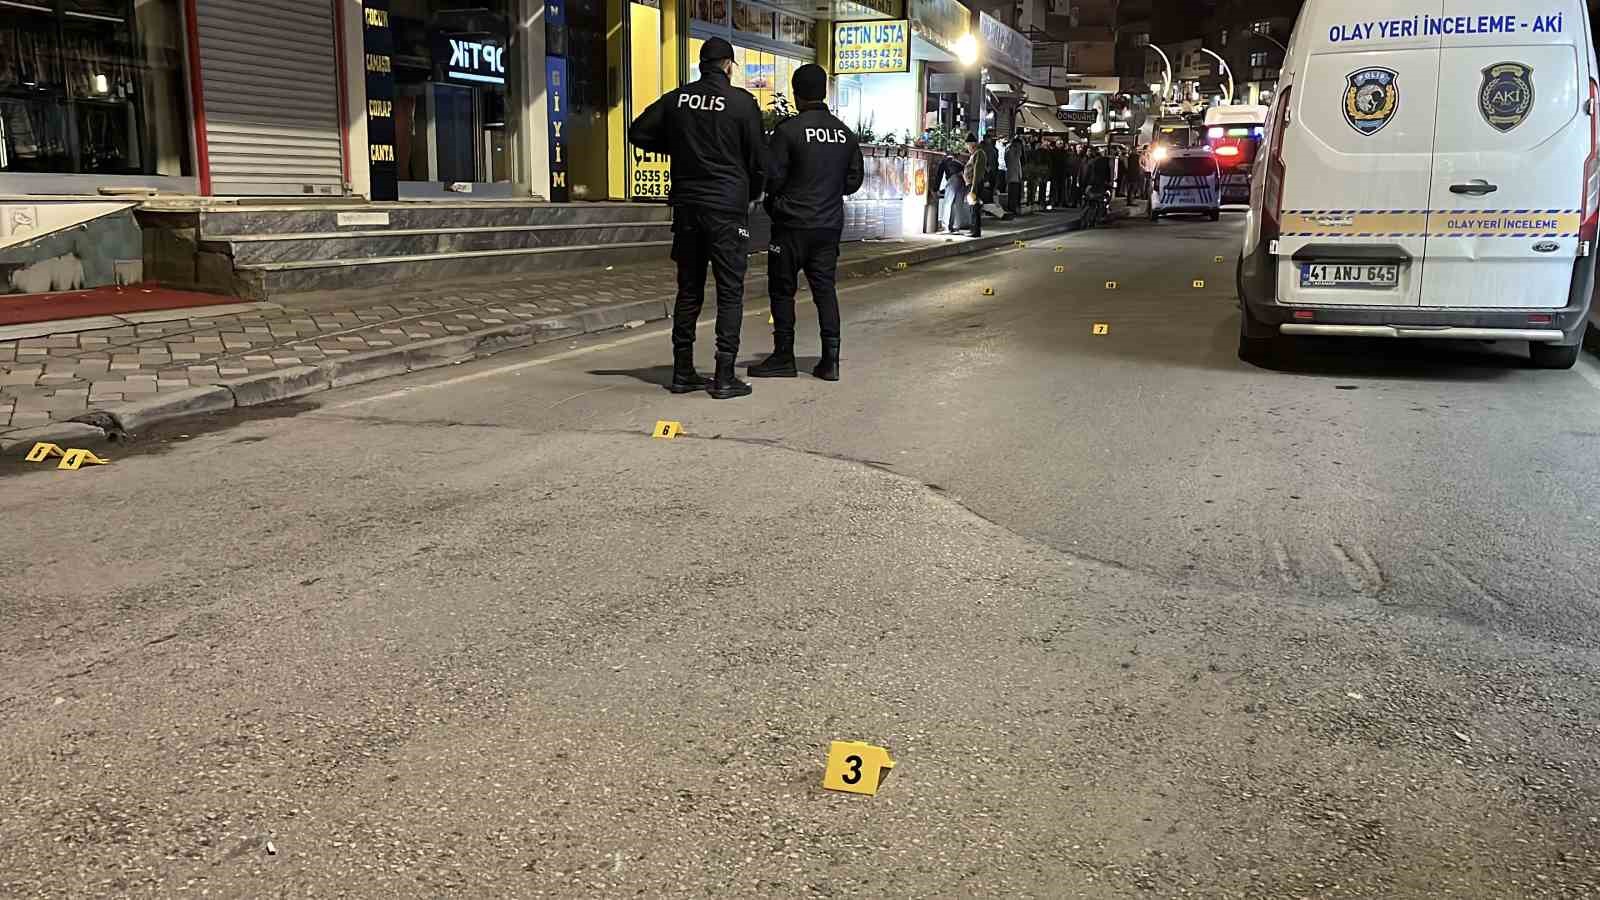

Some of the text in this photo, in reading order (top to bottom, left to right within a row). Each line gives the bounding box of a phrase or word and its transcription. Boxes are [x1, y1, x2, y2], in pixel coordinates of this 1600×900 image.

[875, 23, 904, 43] USTA
[1330, 22, 1374, 42] OLAY
[1378, 15, 1418, 37] YERİ
[1424, 14, 1516, 36] İNCELEME
[1532, 12, 1563, 33] AKİ
[839, 49, 860, 59] 0535
[862, 48, 878, 58] 943
[880, 48, 891, 57] 42
[839, 58, 903, 70] 0543 837 64 79
[370, 144, 394, 165] ÇANTA
[634, 170, 660, 182] 0535
[634, 184, 660, 195] 0543
[1447, 218, 1558, 229] OLAY YERİ İNCELEME
[1311, 266, 1327, 281] 41
[1334, 266, 1360, 281] ANJ
[1367, 267, 1396, 281] 645
[662, 424, 670, 436] 6
[66, 454, 78, 466] 4
[842, 755, 863, 785] 3
